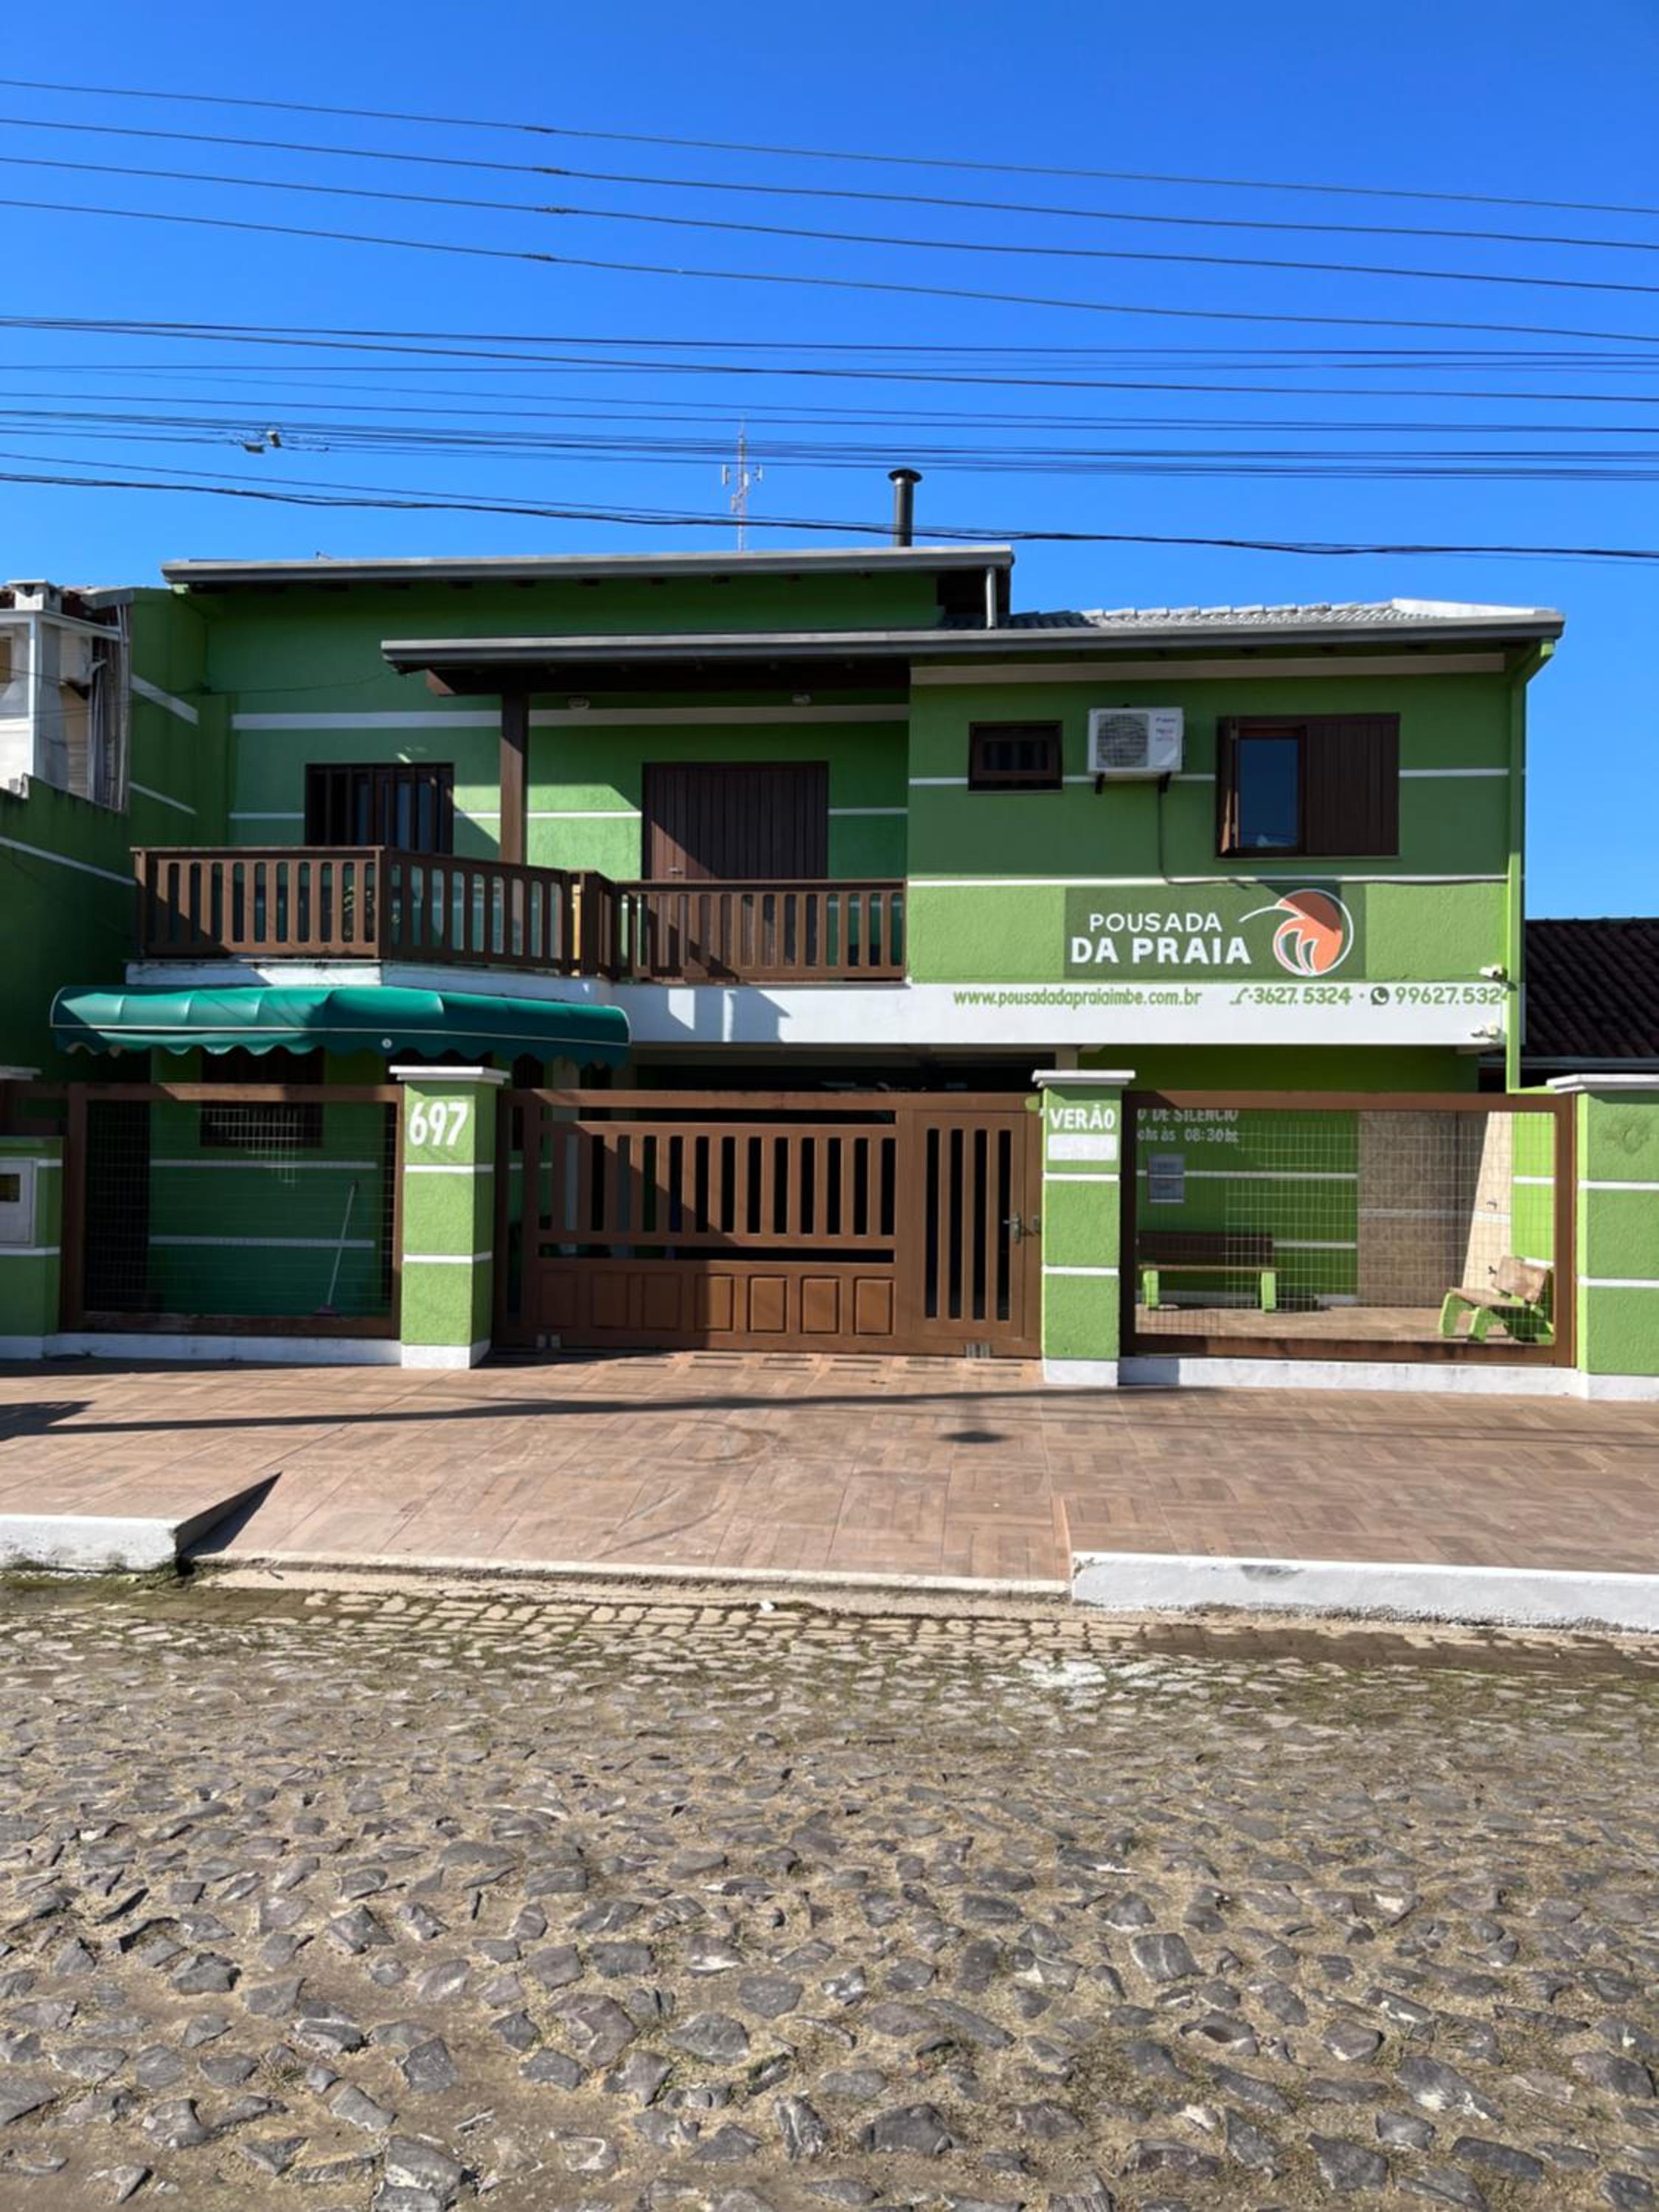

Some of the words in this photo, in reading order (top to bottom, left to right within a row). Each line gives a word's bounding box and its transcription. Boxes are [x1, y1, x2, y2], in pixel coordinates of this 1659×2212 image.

[1089, 912, 1223, 933] POUSADA
[1071, 936, 1120, 964] DA
[1132, 936, 1252, 965] PRAIA
[953, 987, 1203, 1010] www.pousadadapraiaimbe.com.br
[1395, 987, 1508, 1006] 99627.532
[408, 1102, 469, 1147] 697
[1048, 1104, 1116, 1130] VERÃO
[1152, 1108, 1169, 1122] DE
